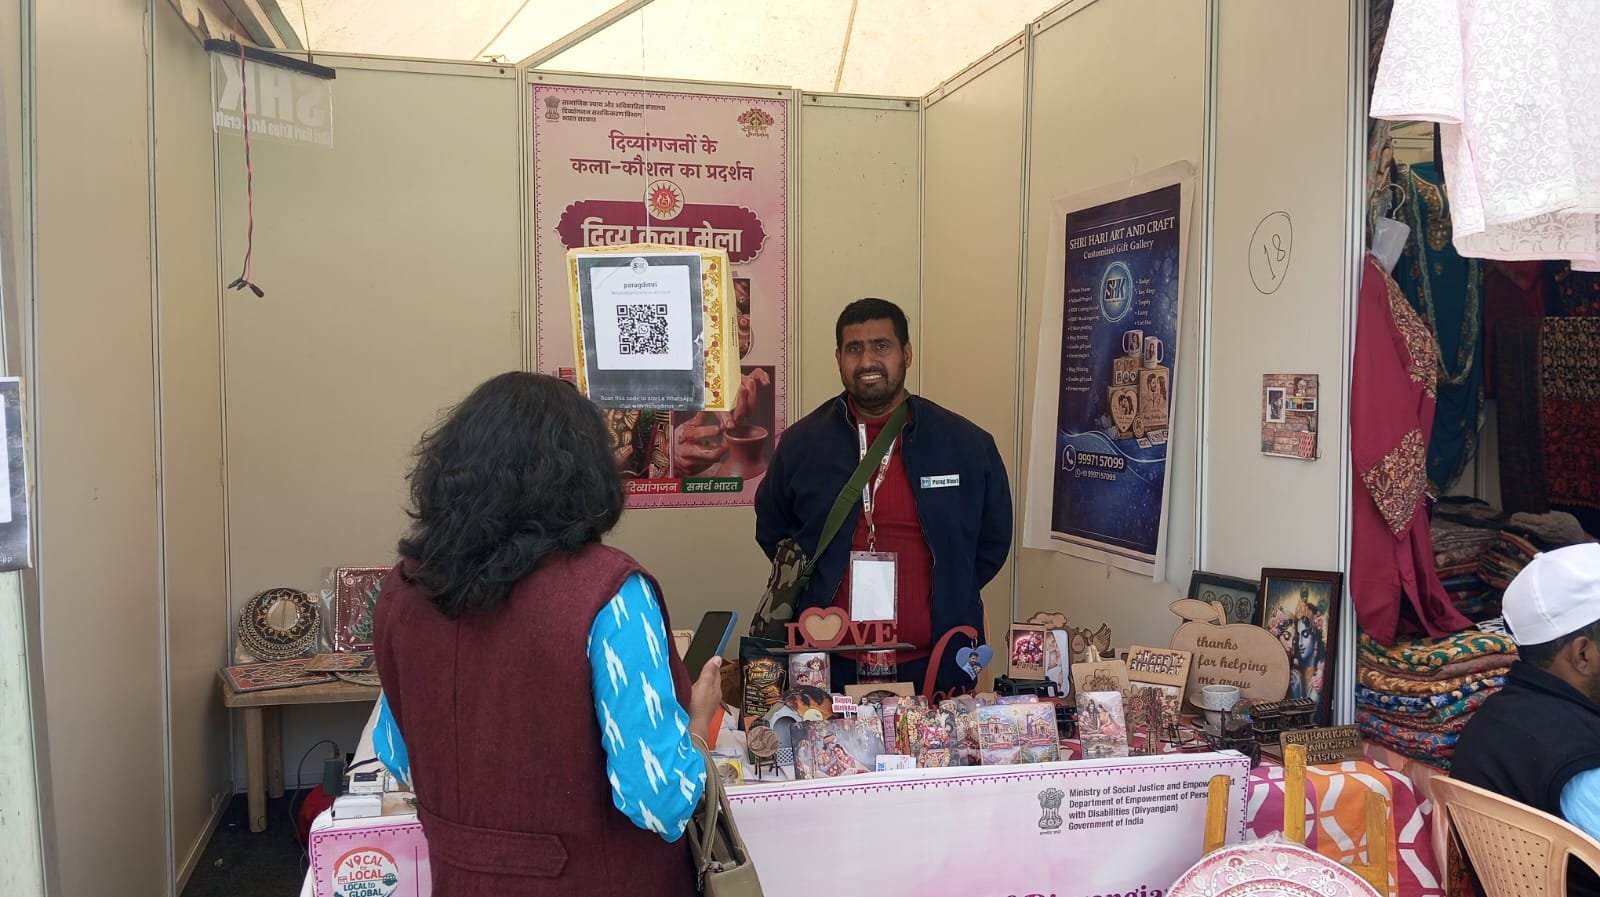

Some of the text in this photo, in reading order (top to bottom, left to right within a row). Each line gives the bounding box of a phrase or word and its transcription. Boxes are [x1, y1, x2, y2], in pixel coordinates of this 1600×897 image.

[608, 129, 718, 155] दिव्यांगजनों के
[570, 155, 754, 182] कला-कौशल का प्रदर्शन
[1069, 217, 1175, 250] SHRI HARI ART AND CRAFT
[1083, 239, 1154, 259] Customized Gift Gallery
[1263, 233, 1286, 280] 18
[686, 480, 713, 492] समर्थ
[714, 481, 738, 491] भारत
[1197, 635, 1238, 651] thanks
[1197, 654, 1268, 676] for helping
[1197, 676, 1217, 686] me
[1286, 733, 1308, 743] SHRI
[1309, 731, 1332, 741] HARI
[1308, 741, 1327, 752] AND
[1069, 788, 1100, 798] Ministry
[1103, 786, 1111, 794] of
[1112, 785, 1135, 794] Social
[1137, 782, 1165, 792] Justice
[1166, 781, 1181, 790] and
[1069, 797, 1114, 809] Department
[1115, 797, 1124, 805] of
[1125, 794, 1179, 804] Empowerment
[1180, 791, 1188, 800] of
[1068, 803, 1179, 819] with Disabilities (Divyangjan)
[1068, 816, 1144, 831] Government of India
[345, 855, 382, 868] VOCAL
[349, 869, 385, 881] LOCAL
[343, 883, 368, 891] LOCAL
[349, 888, 384, 897] GLOBAL
